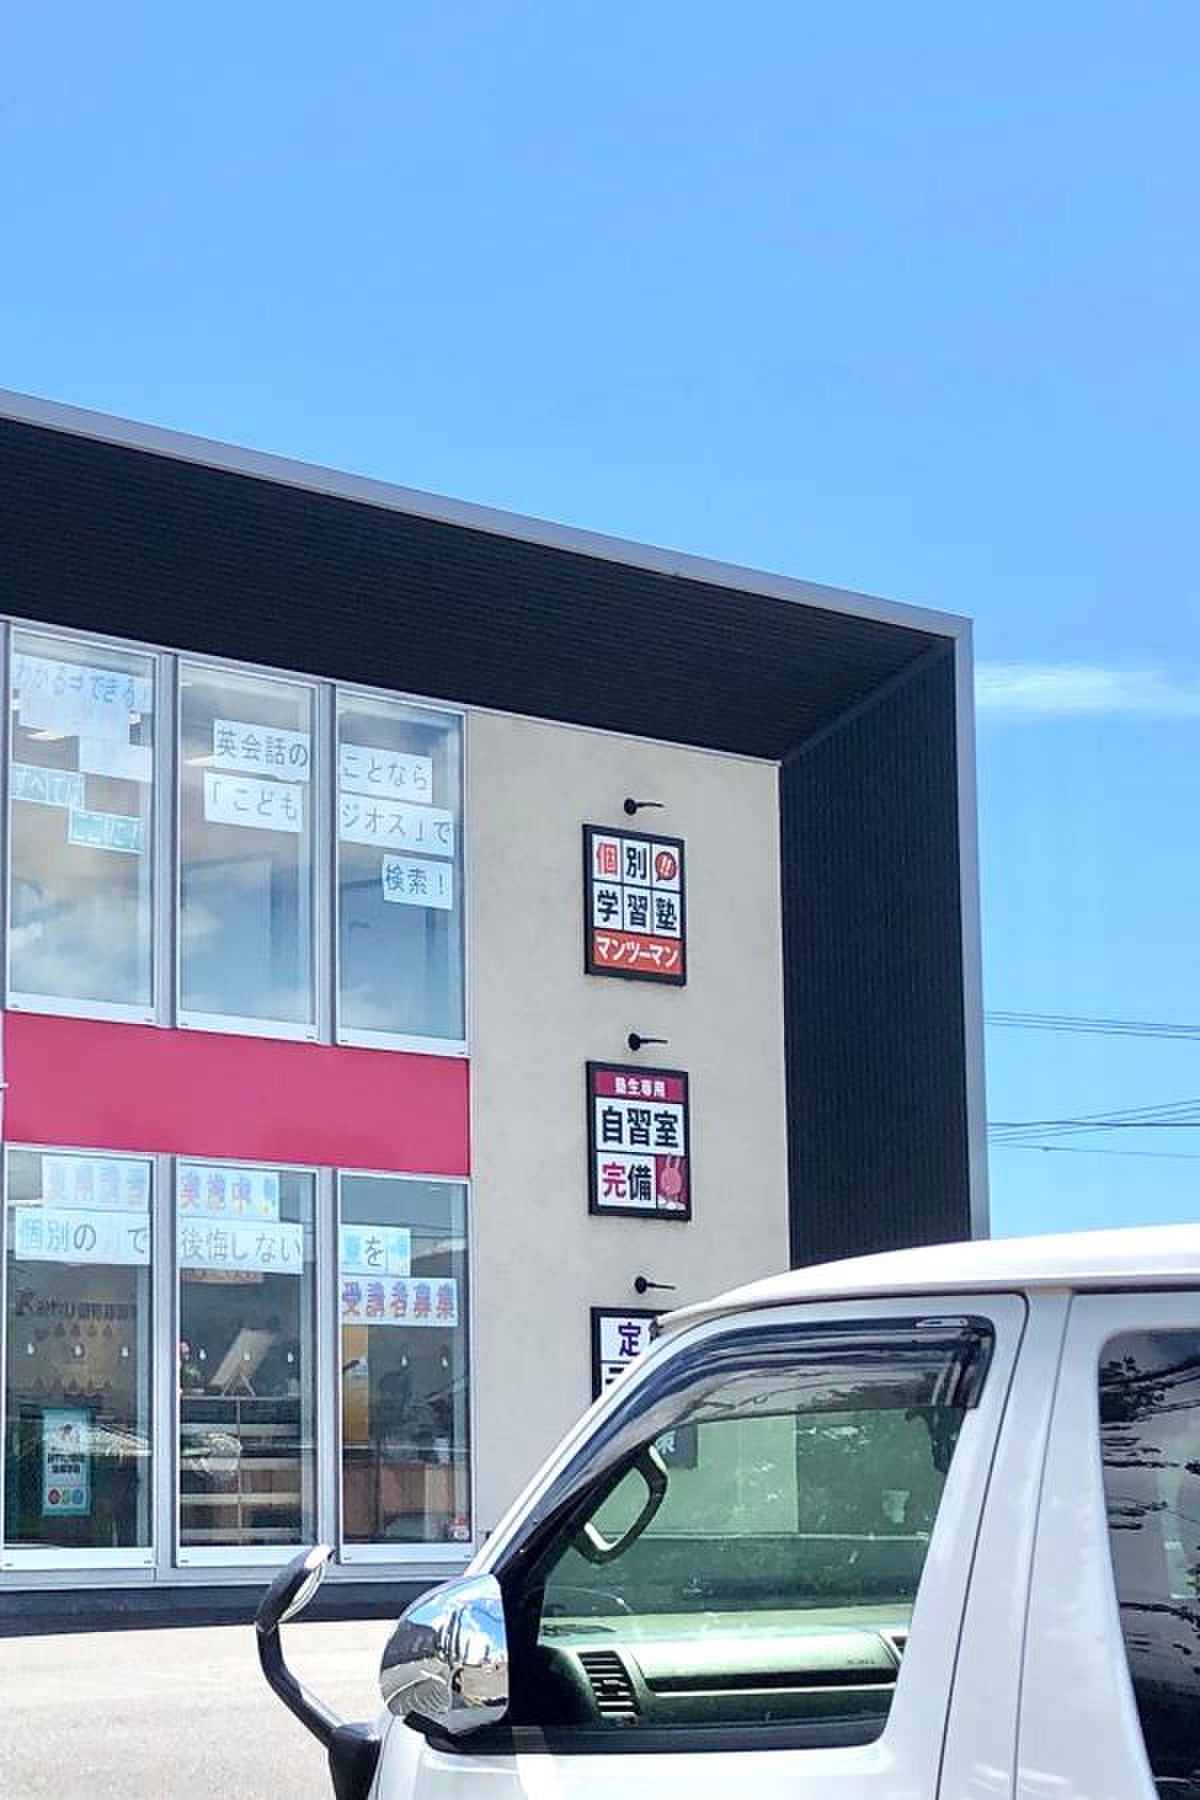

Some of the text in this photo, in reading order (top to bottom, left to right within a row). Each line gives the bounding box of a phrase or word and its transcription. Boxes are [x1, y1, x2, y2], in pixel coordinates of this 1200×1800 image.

[216, 729, 429, 790] 英会話の ことなら
[597, 889, 677, 931] 学習塾
[595, 936, 678, 967] マンツーマン
[601, 1105, 679, 1149] 自習室
[601, 1160, 652, 1201] 完備
